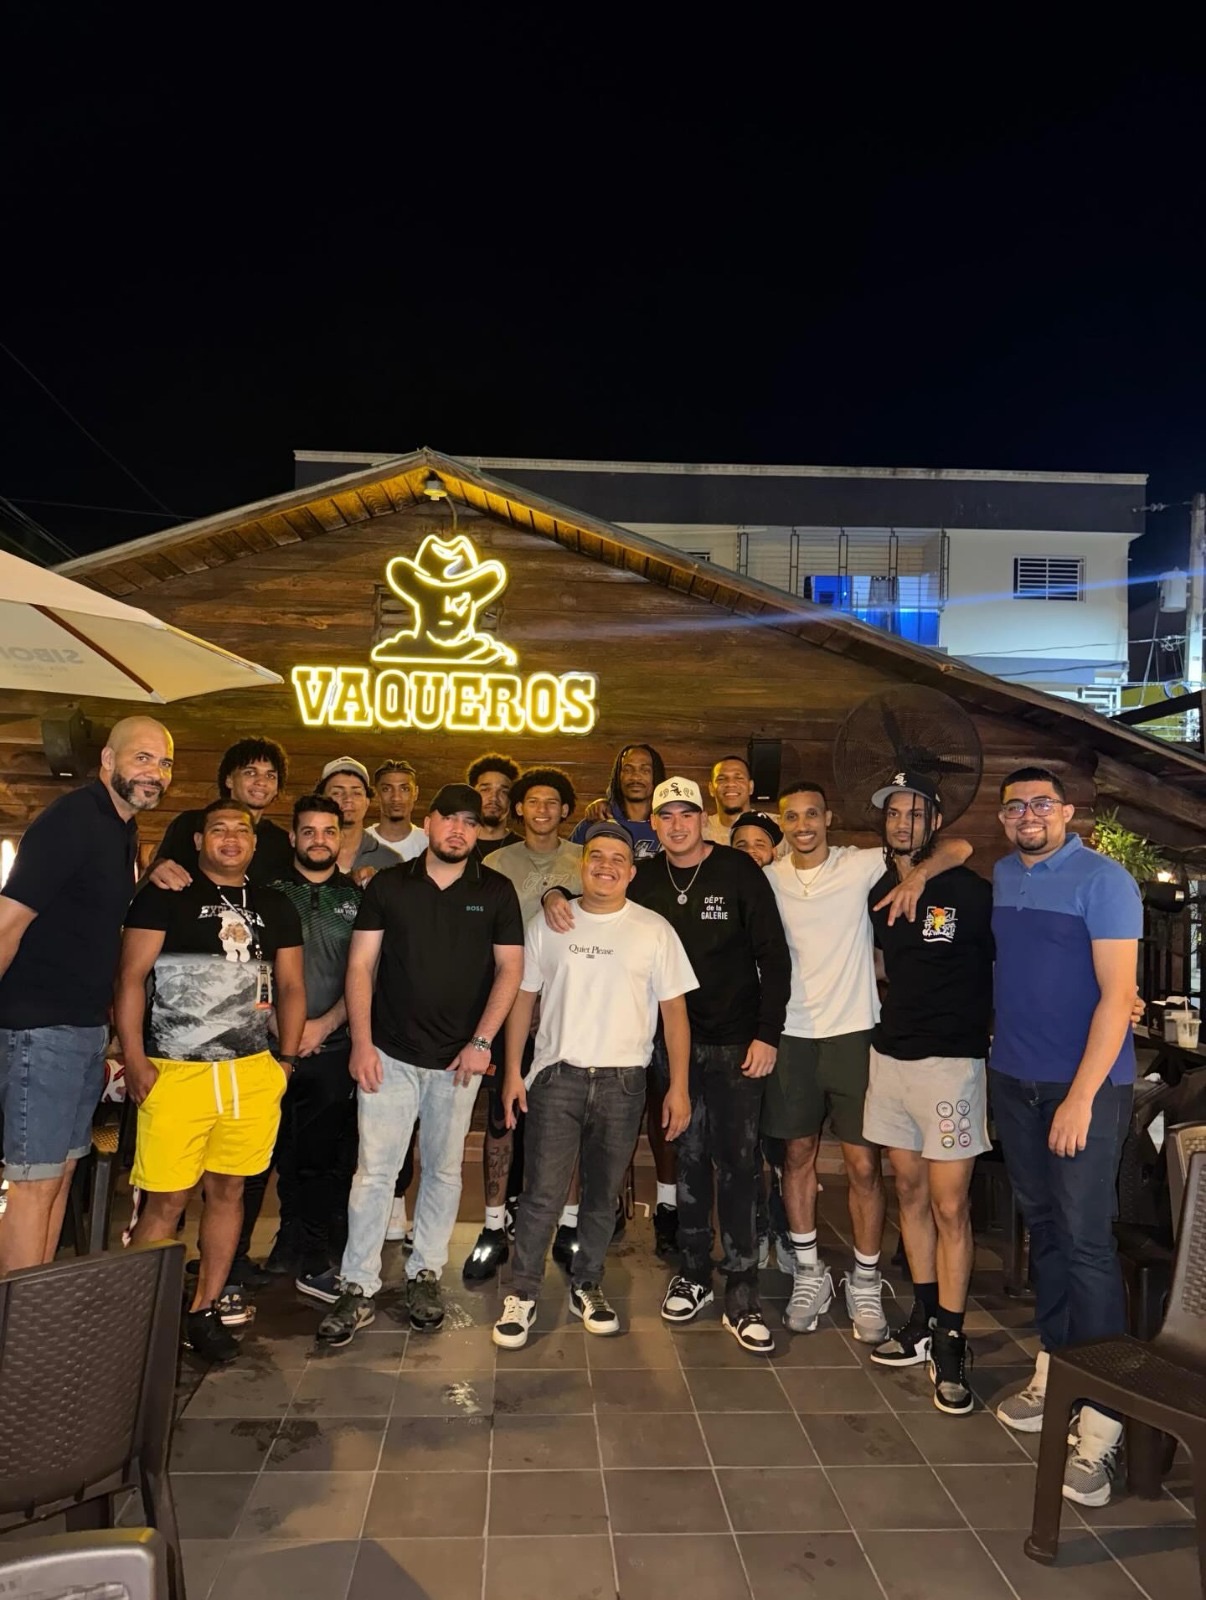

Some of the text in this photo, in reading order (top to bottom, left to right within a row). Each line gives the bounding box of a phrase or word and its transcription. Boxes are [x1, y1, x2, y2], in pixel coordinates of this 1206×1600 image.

[291, 666, 597, 733] VAQUEROS
[701, 911, 729, 920] GALERIE
[568, 944, 614, 955] Quiet Please
